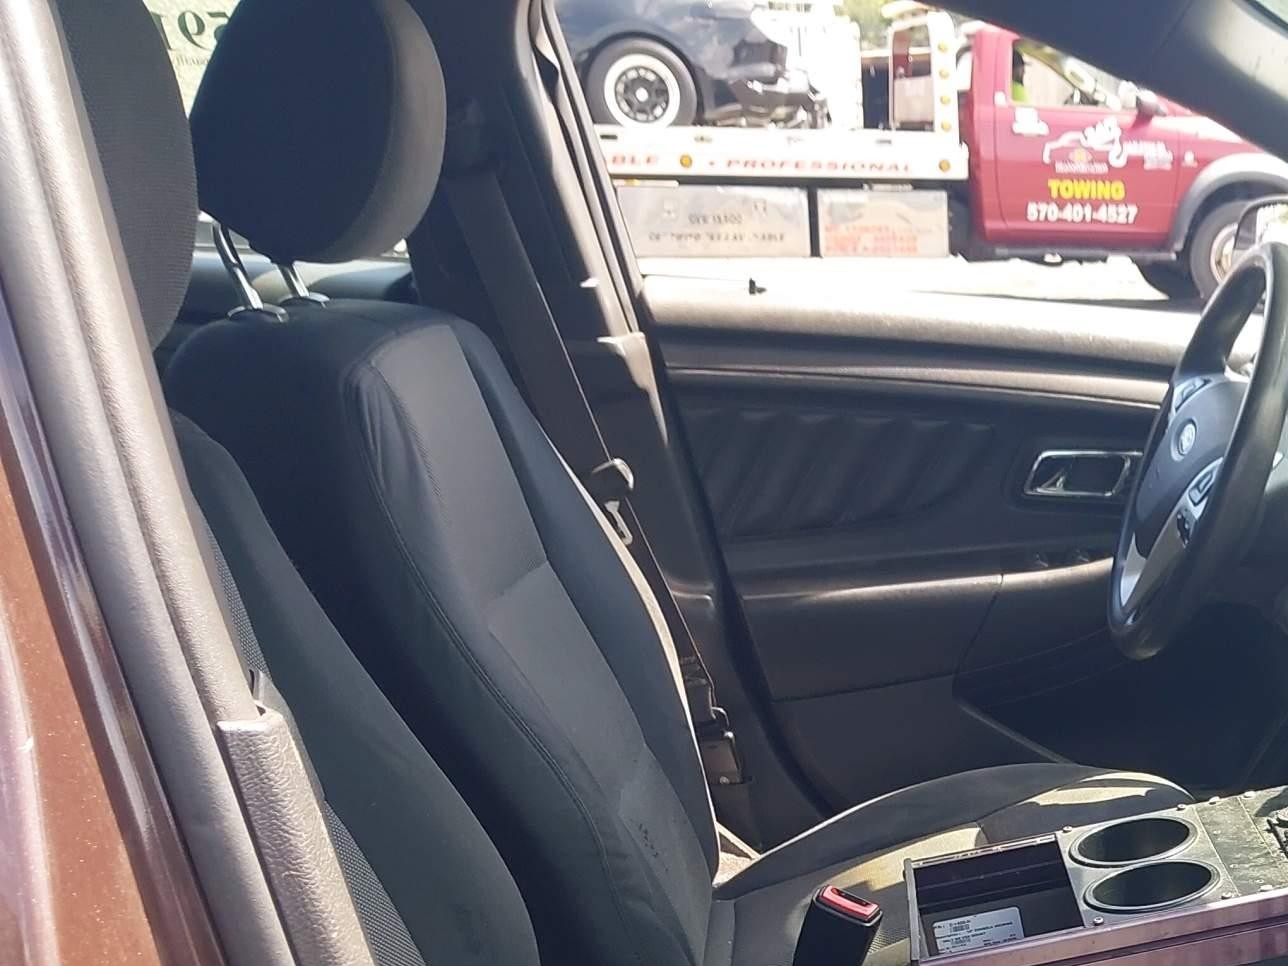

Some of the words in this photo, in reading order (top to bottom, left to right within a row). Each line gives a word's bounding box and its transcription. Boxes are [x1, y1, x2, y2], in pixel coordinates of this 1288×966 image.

[726, 158, 912, 173] PROFESSIONAL
[1048, 178, 1125, 200] TOWING
[1026, 201, 1138, 224] 570-401-4527
